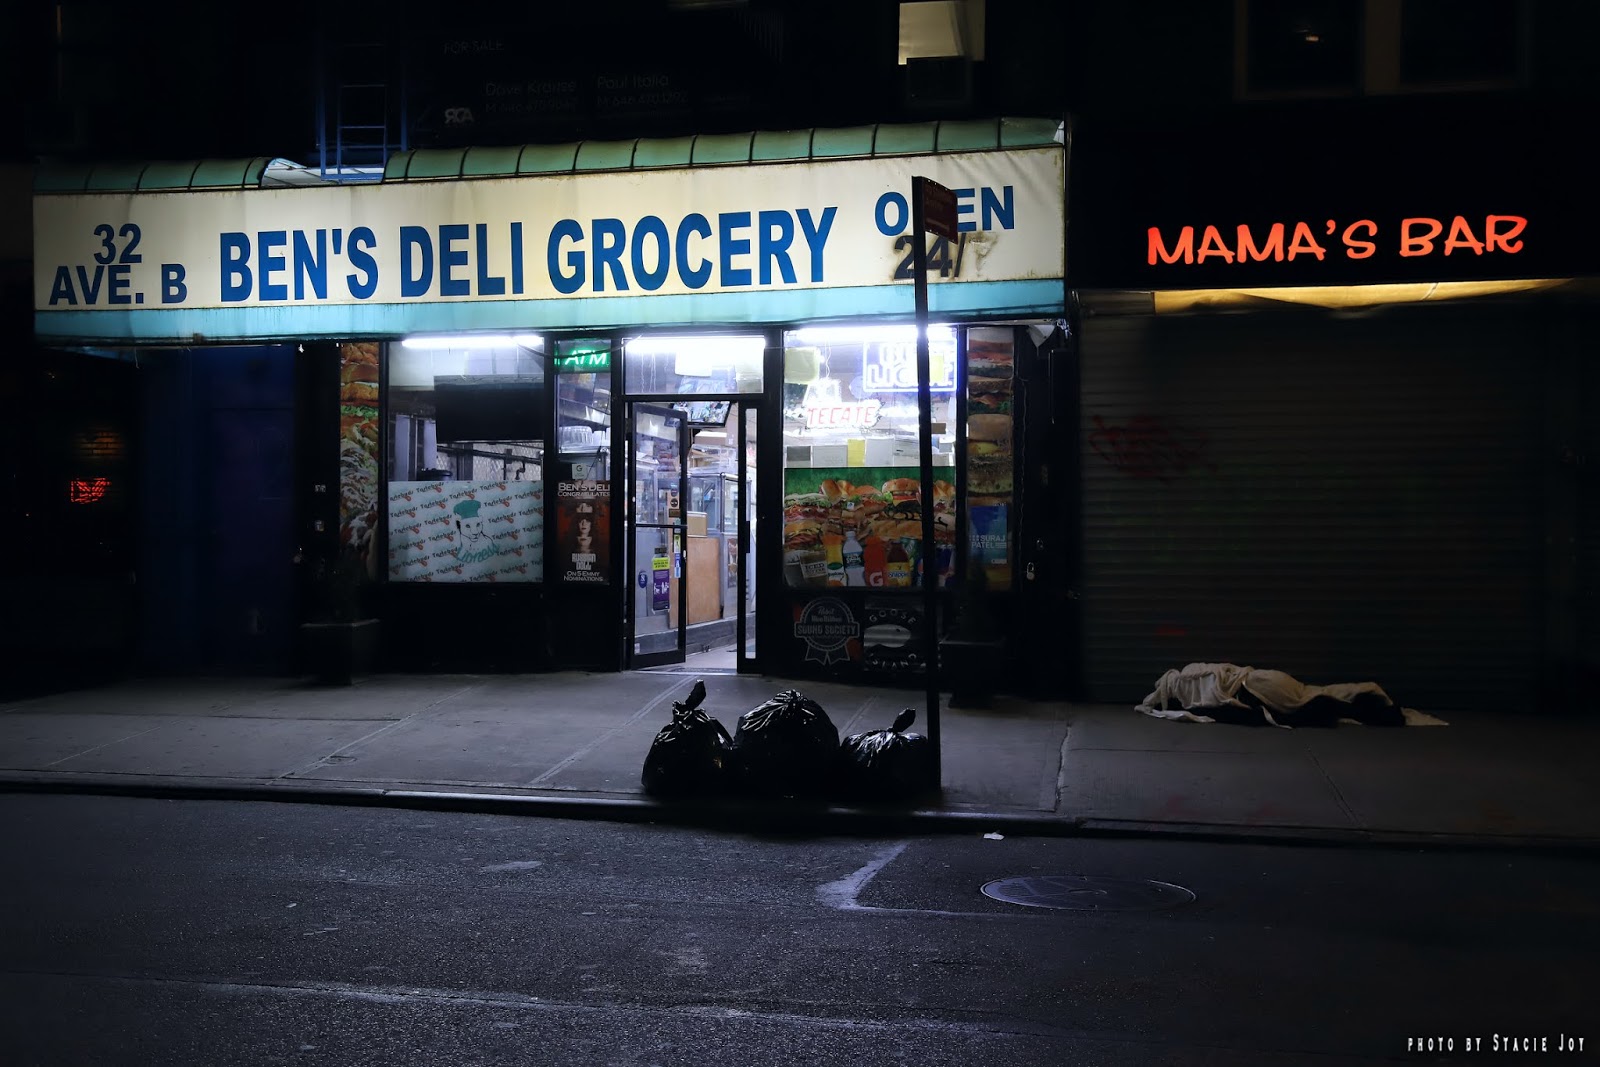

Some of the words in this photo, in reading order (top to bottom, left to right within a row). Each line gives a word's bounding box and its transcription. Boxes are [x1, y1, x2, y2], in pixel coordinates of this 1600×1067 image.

[874, 185, 1015, 237] OEN
[93, 223, 142, 264] 32
[220, 226, 379, 302] BEN'S
[400, 221, 524, 297] DELI
[547, 206, 838, 294] GROCERY
[1147, 219, 1378, 265] MAMA'S
[1399, 215, 1528, 257] BAR
[49, 264, 144, 305] AVE.
[161, 263, 188, 304] B
[564, 349, 607, 366] ATM
[807, 406, 877, 425] TECATE
[589, 483, 610, 492] DELI
[971, 541, 995, 549] PATEL
